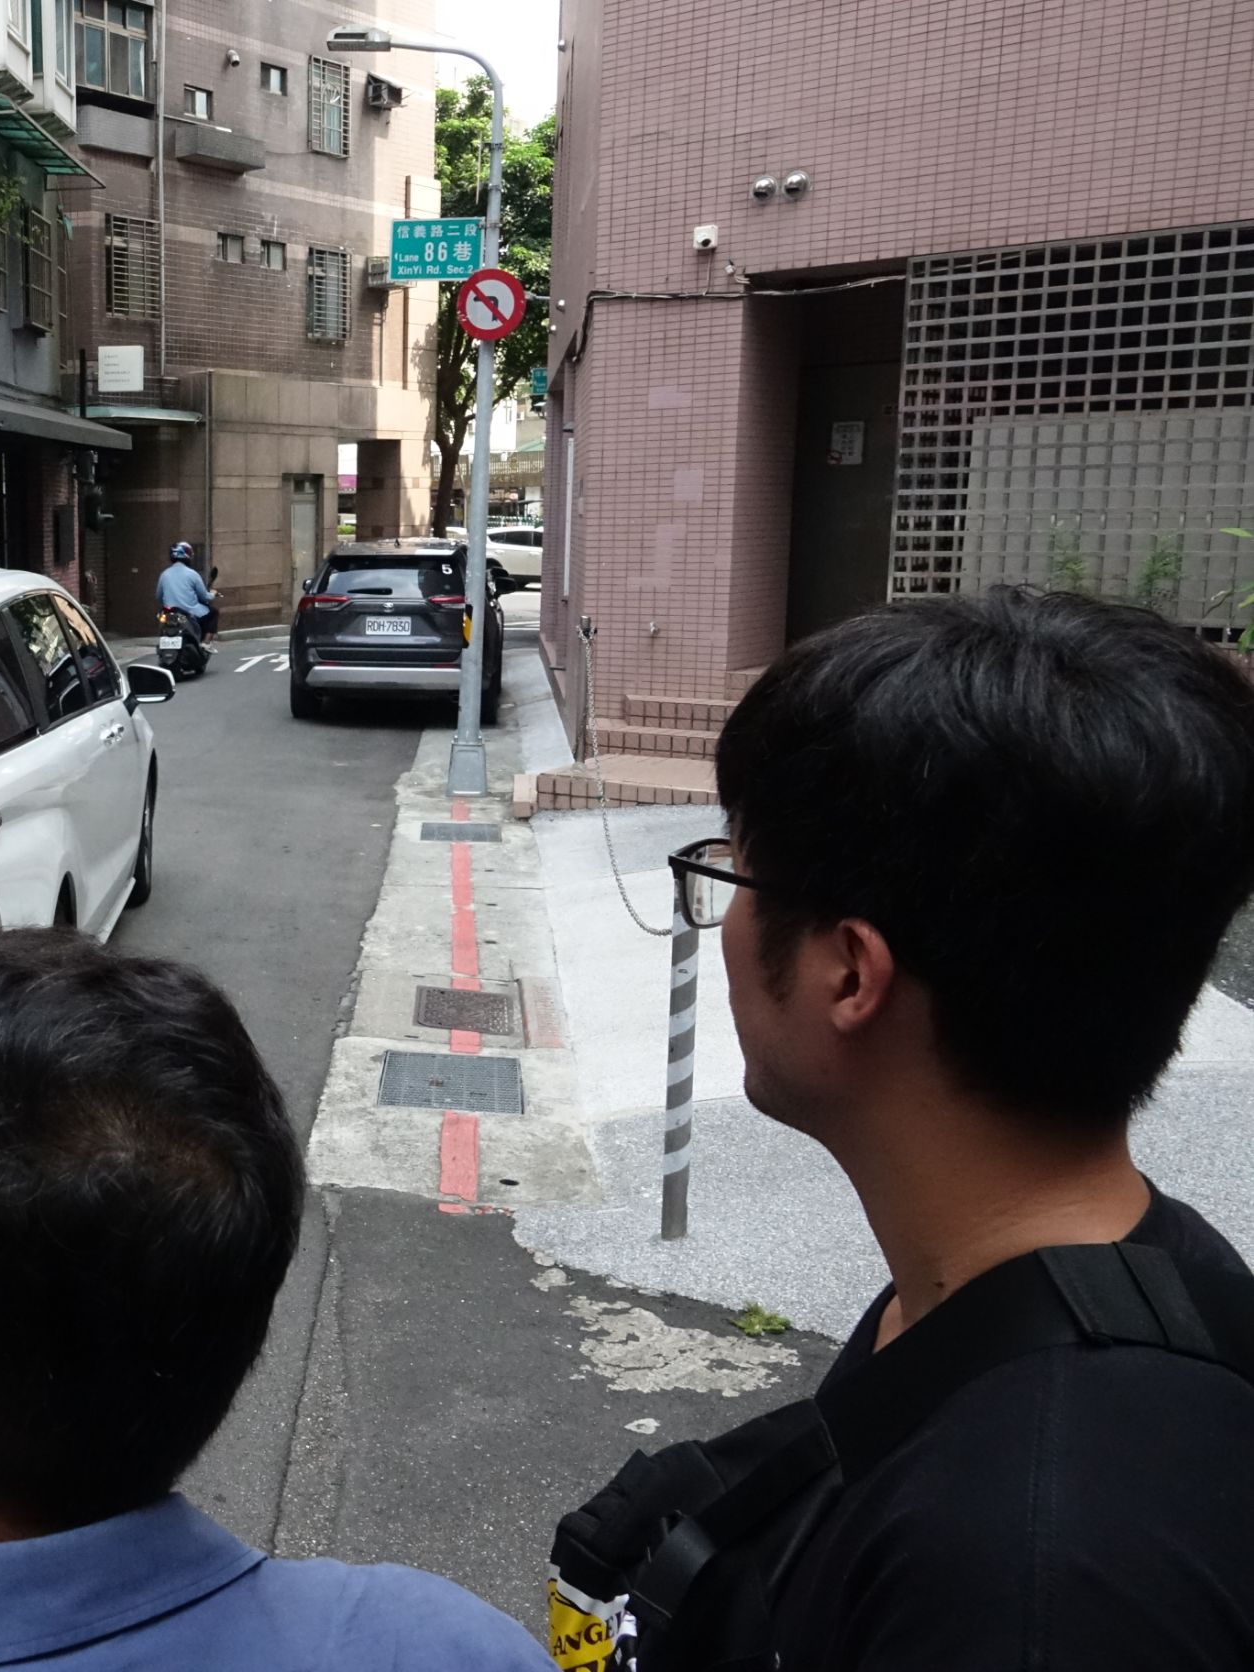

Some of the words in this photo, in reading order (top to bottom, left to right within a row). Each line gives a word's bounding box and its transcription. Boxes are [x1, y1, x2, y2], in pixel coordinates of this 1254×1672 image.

[397, 223, 477, 239] 信義路二段
[399, 253, 419, 262] Lane
[397, 265, 422, 275] XinYi
[426, 265, 442, 275] Rd.
[442, 564, 453, 574] 5
